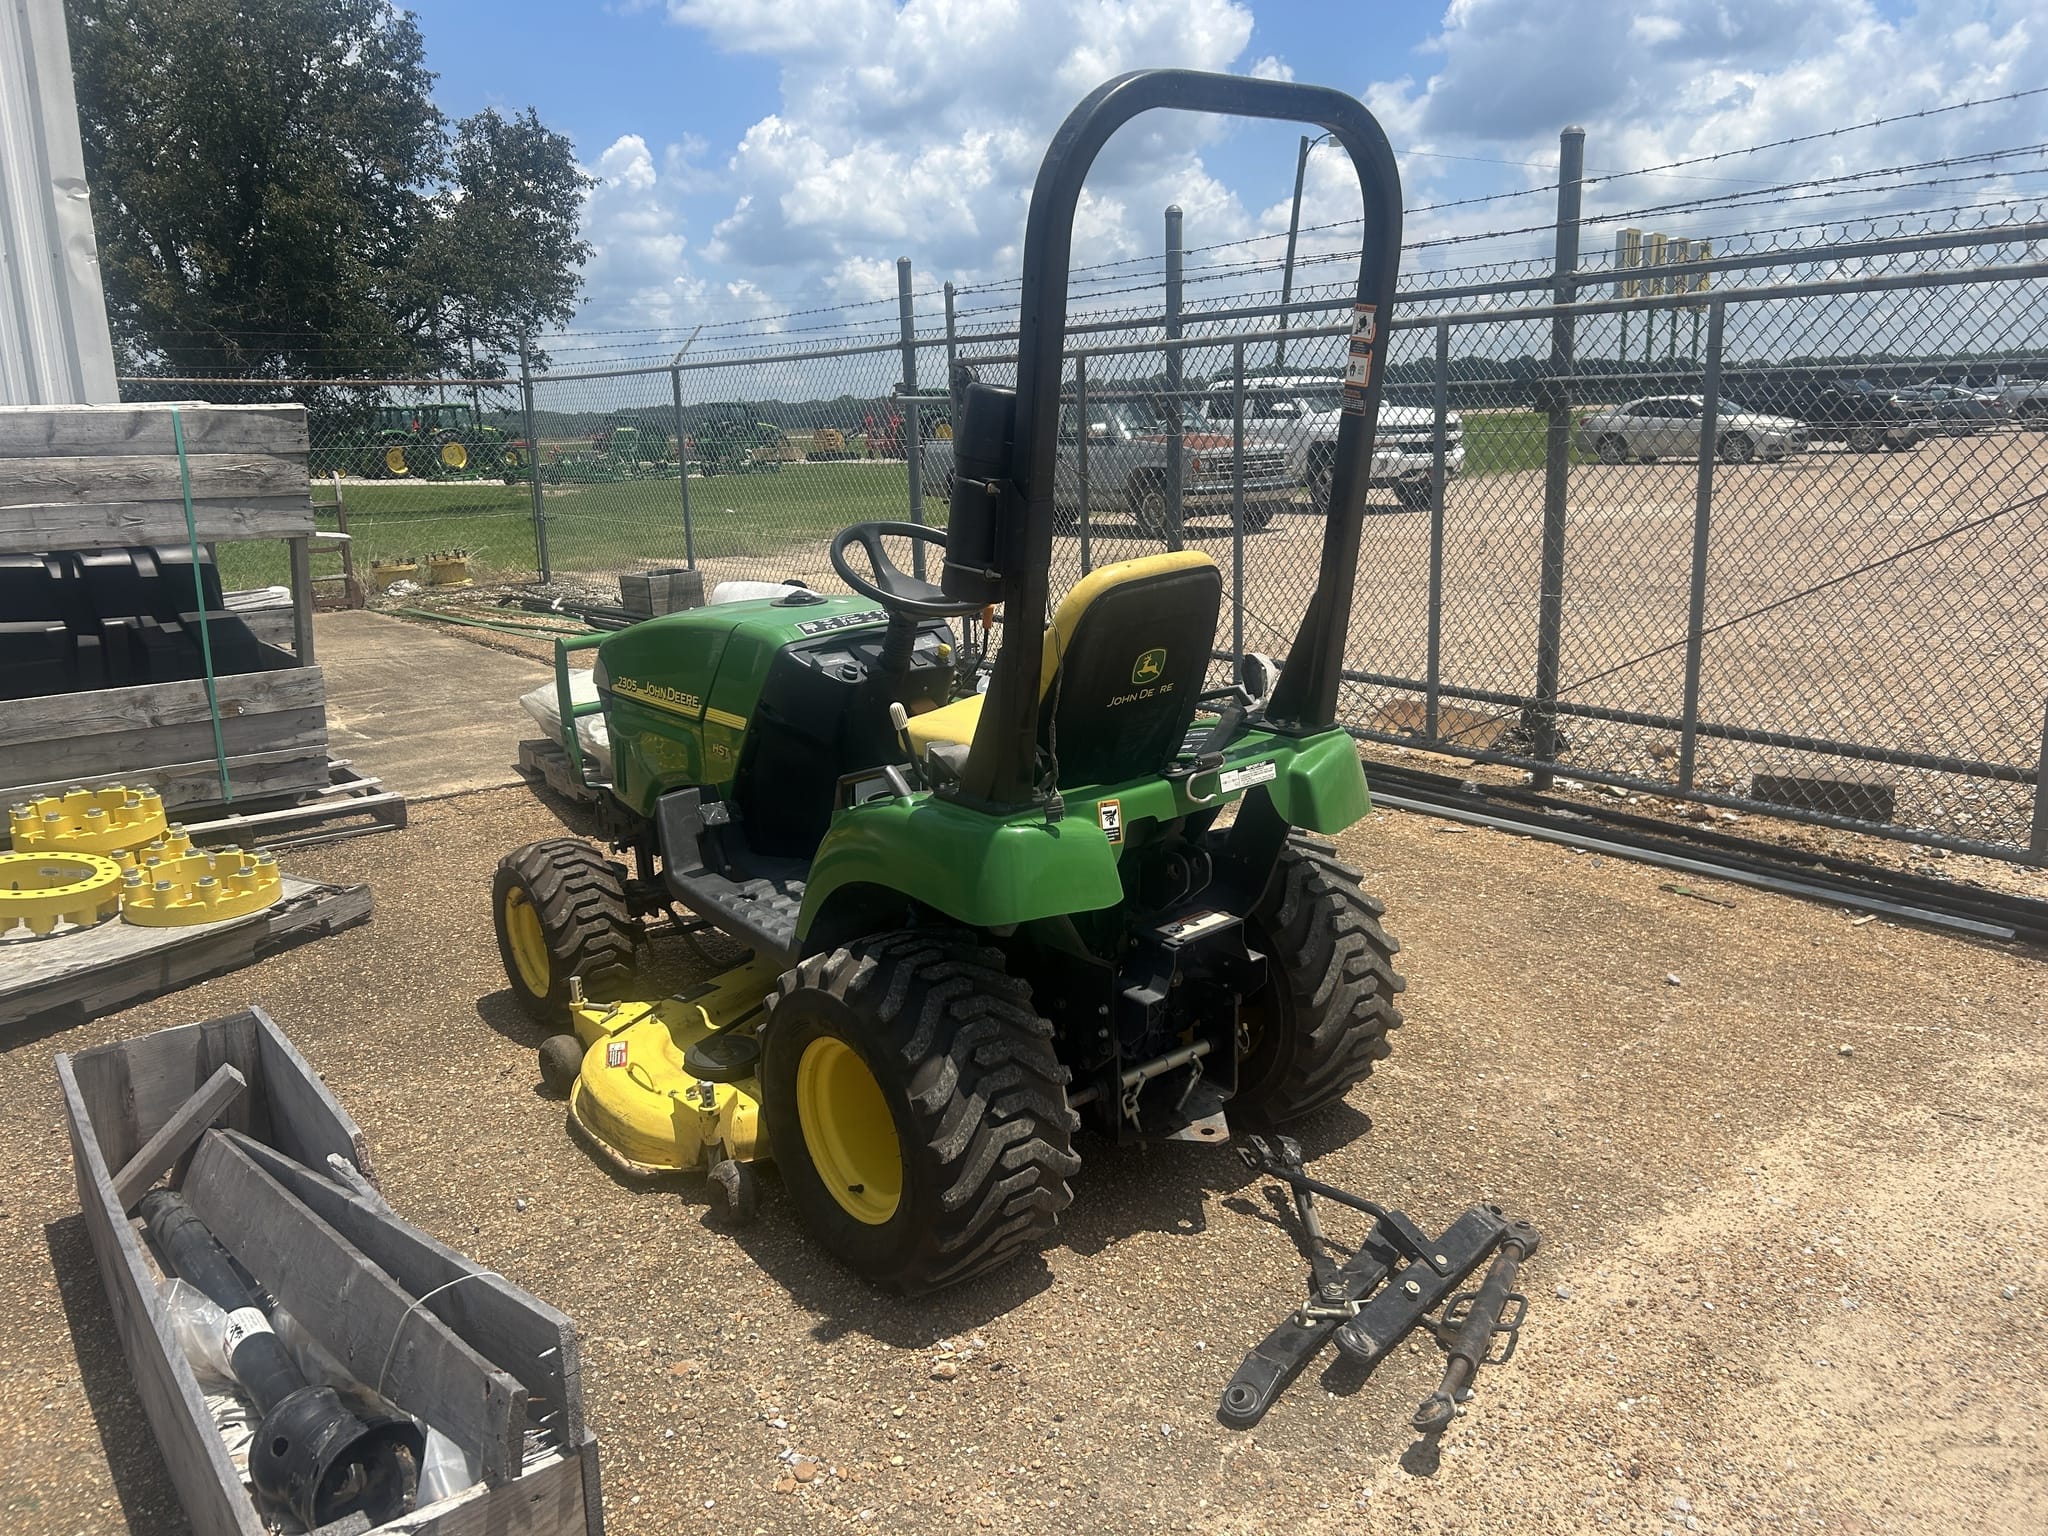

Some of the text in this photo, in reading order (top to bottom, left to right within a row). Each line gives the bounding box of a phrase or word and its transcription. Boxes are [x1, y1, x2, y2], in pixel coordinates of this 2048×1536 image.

[618, 676, 700, 707] 2305 JOHN DEERE
[1106, 693, 1138, 708] JOHN
